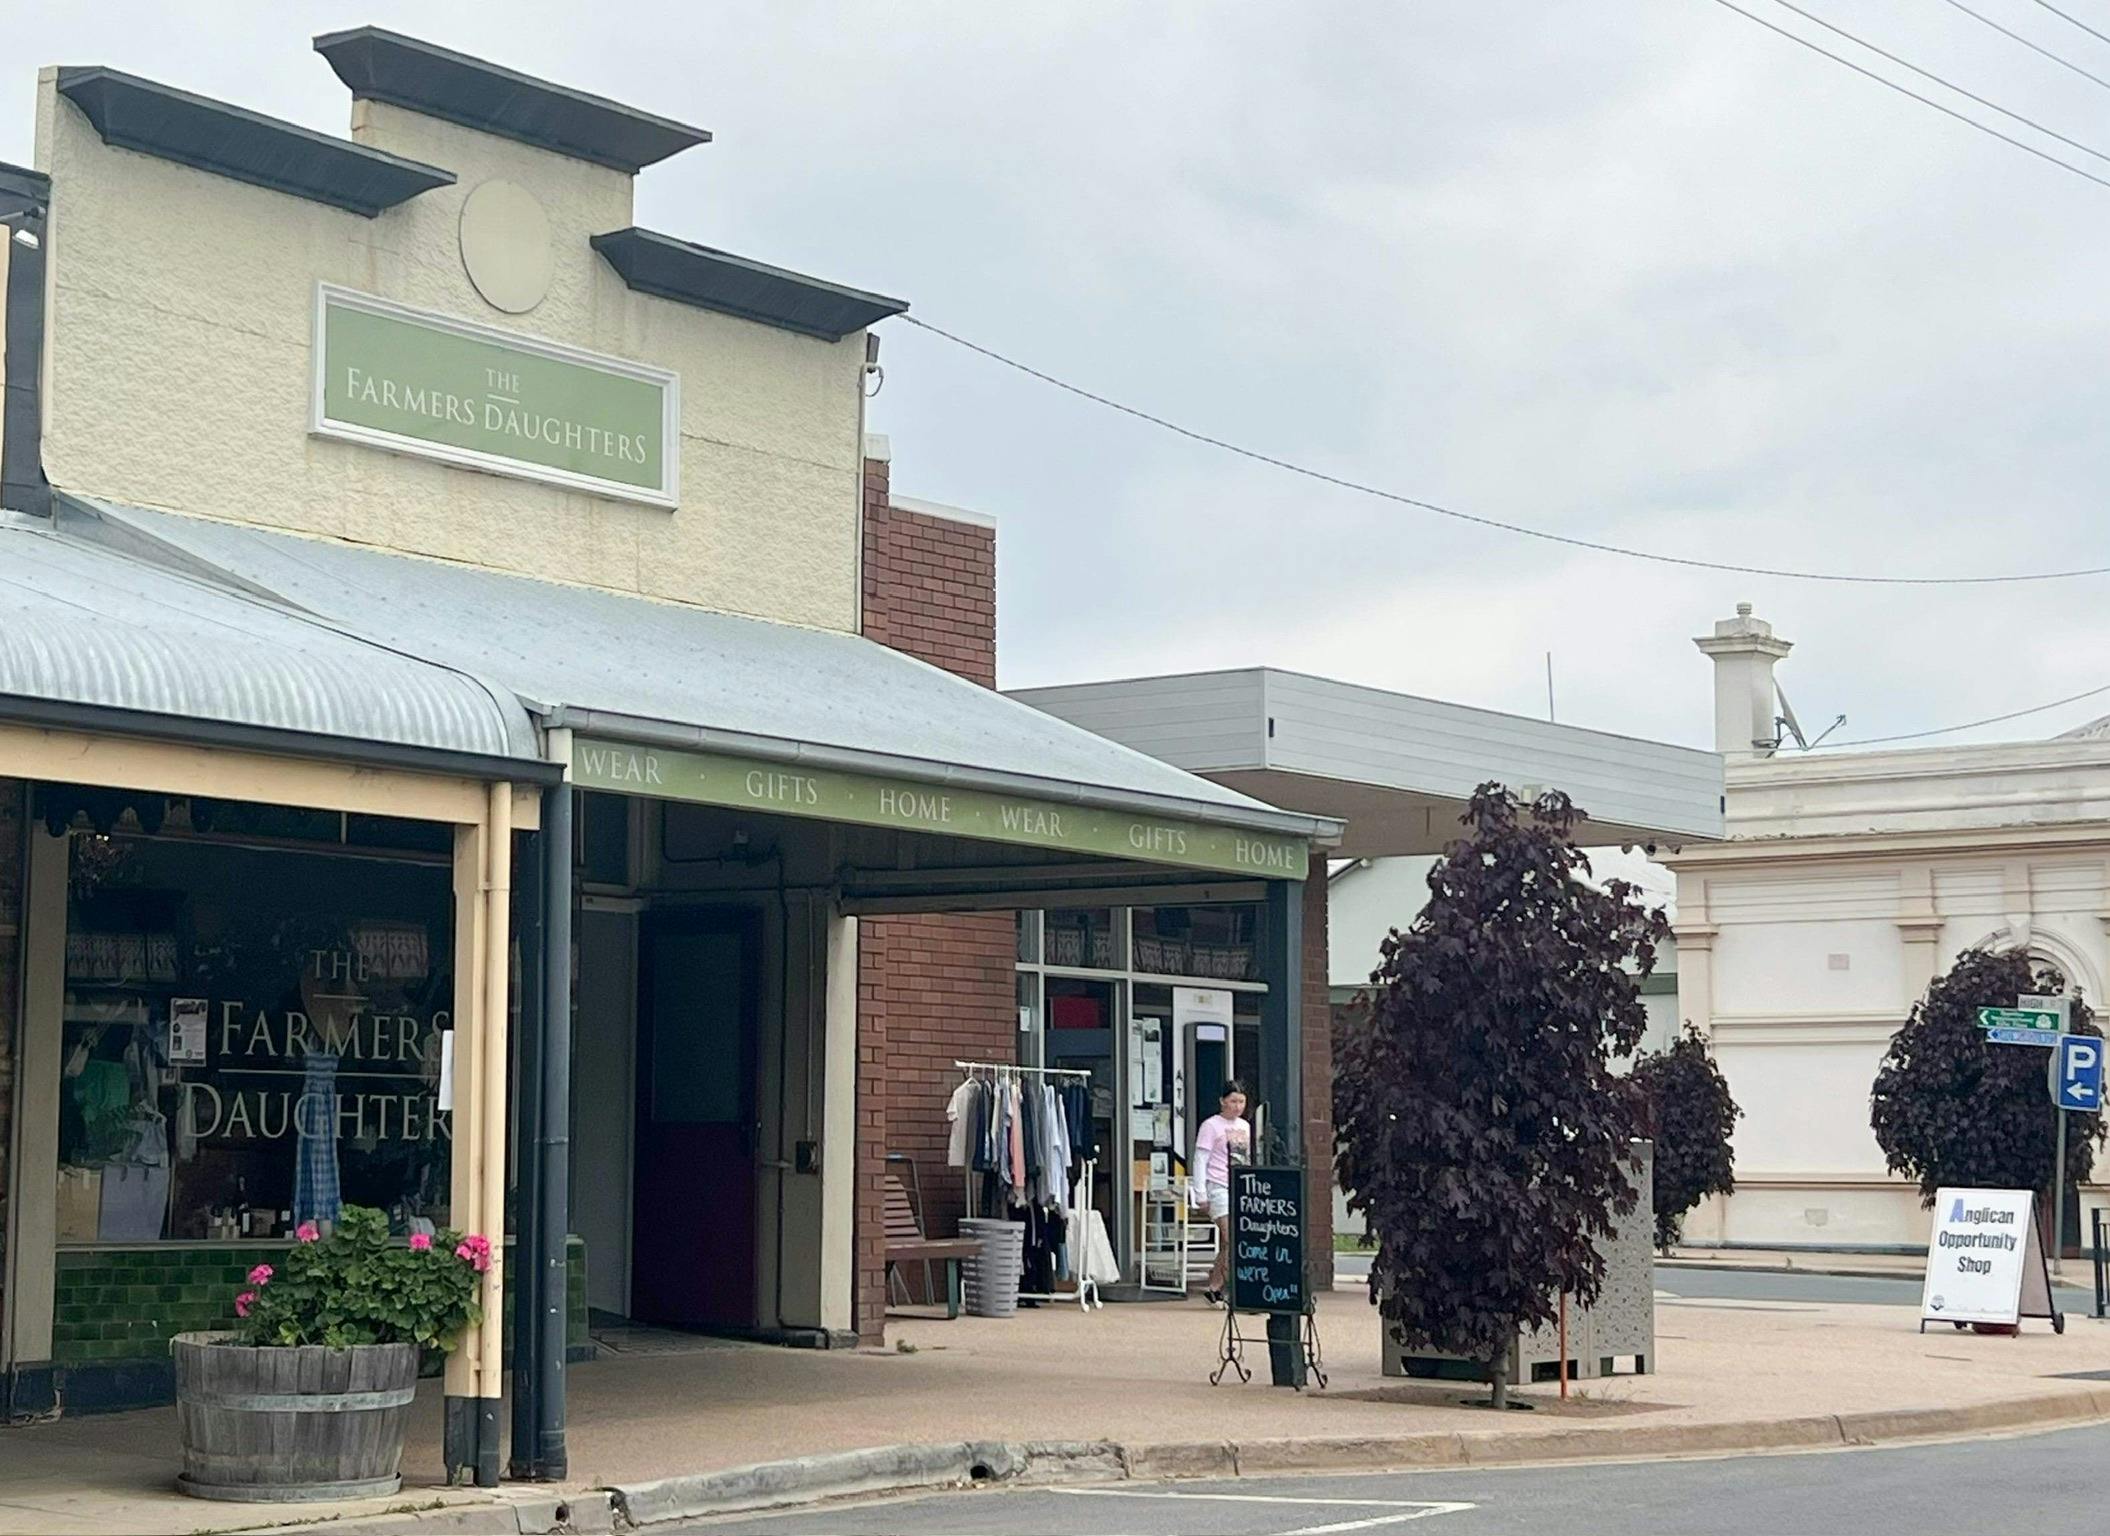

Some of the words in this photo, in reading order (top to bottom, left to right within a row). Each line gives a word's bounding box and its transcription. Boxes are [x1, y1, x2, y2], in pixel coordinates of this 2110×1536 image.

[486, 368, 520, 393] THE
[346, 367, 475, 426] FARMERS
[485, 404, 646, 464] DAUGHTERS
[581, 747, 662, 784] WEAR
[746, 770, 818, 804] GIFTS
[879, 788, 951, 823] HOME
[1001, 805, 1063, 838] WEAR
[1129, 823, 1187, 854] GIFTS
[1235, 839, 1294, 870] HOME
[311, 950, 369, 982] THE
[2066, 1044, 2097, 1081] P
[1240, 1173, 1271, 1195] The
[1240, 1196, 1297, 1217] FARMERS
[1949, 1198, 2014, 1225] Anglican
[1240, 1216, 1299, 1243] Daughters
[1939, 1230, 2017, 1251] Opportunity
[1238, 1241, 1268, 1260] Come
[1275, 1246, 1292, 1264] in
[1237, 1266, 1270, 1282] were
[1957, 1256, 1992, 1275] Shop
